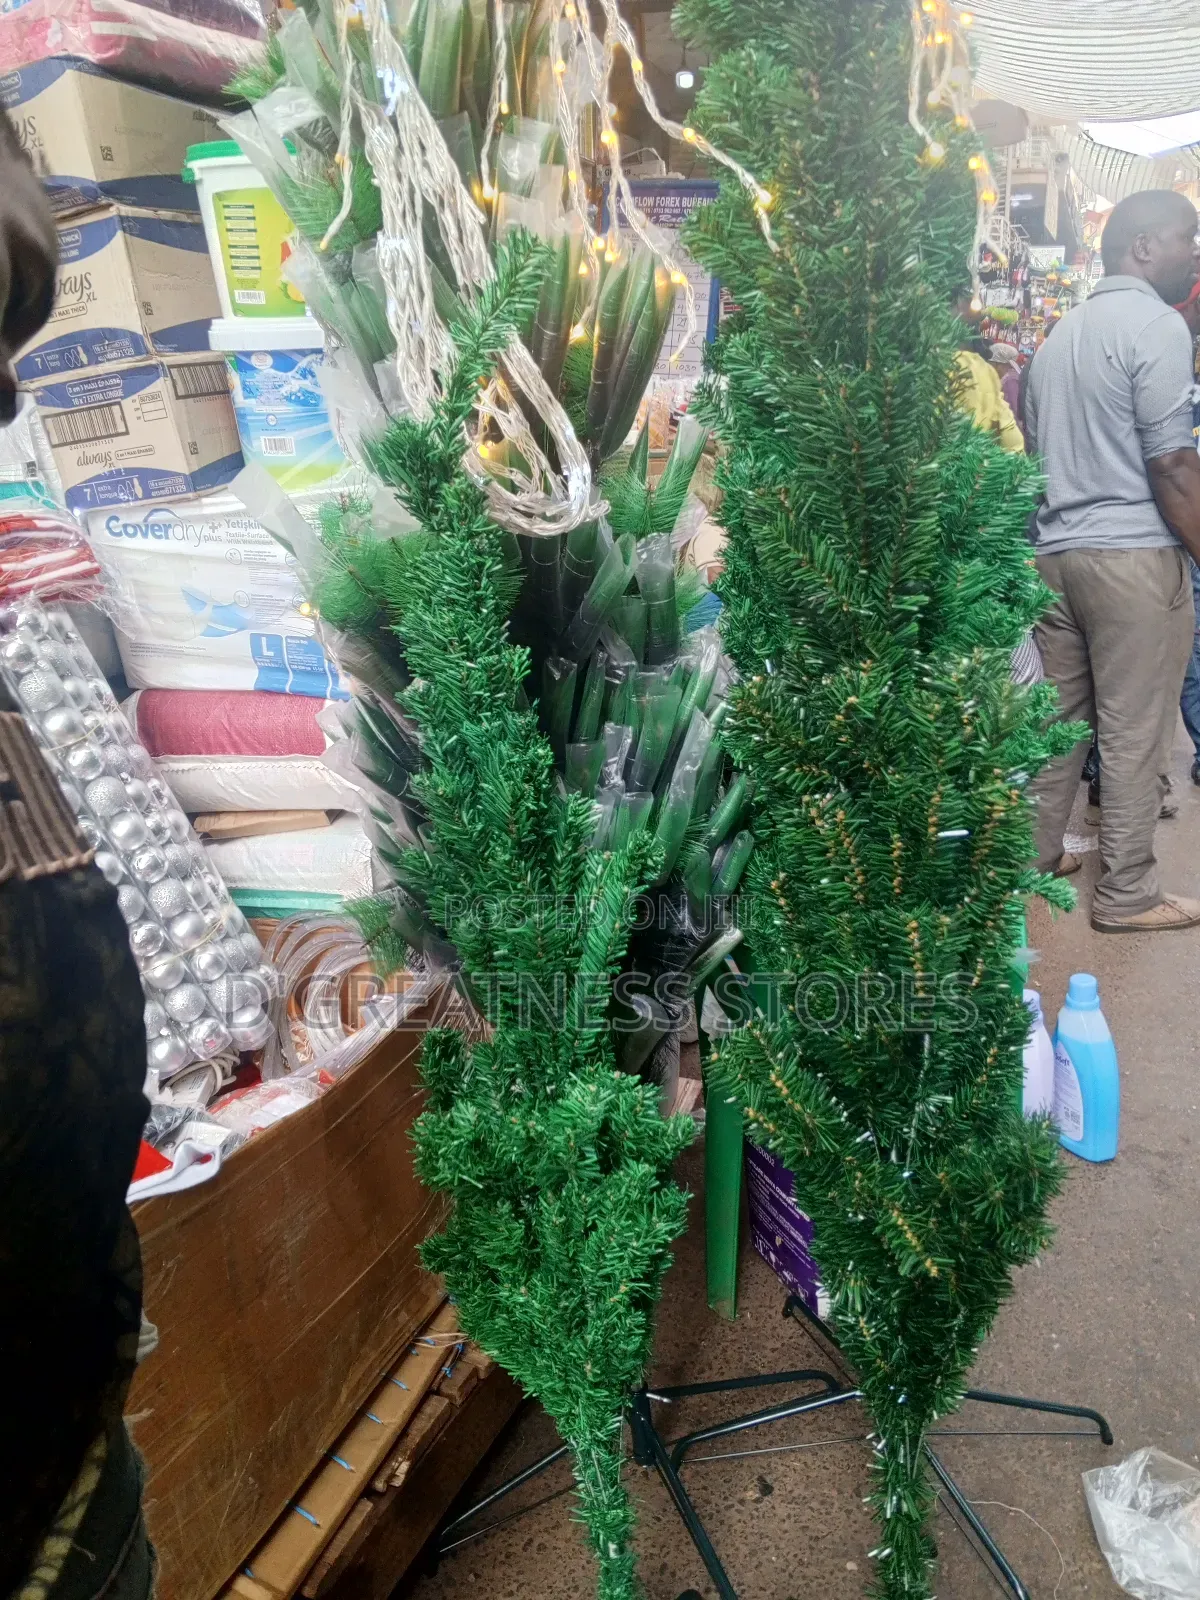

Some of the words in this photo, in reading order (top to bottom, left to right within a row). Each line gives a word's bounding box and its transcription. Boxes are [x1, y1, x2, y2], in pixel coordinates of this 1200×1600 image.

[31, 138, 44, 149] XL
[655, 196, 680, 208] FOREX
[61, 234, 80, 244] THICK
[86, 292, 98, 302] XL
[71, 305, 86, 315] THICK
[34, 357, 43, 370] 7
[84, 381, 98, 391] MAXI
[87, 393, 105, 403] EXTRA
[104, 389, 125, 400] LONGUE
[76, 450, 112, 469] always
[83, 488, 91, 502] 7
[99, 491, 117, 500] longue
[105, 514, 204, 548] Coverdry
[203, 533, 223, 544] plus
[261, 636, 275, 656] L
